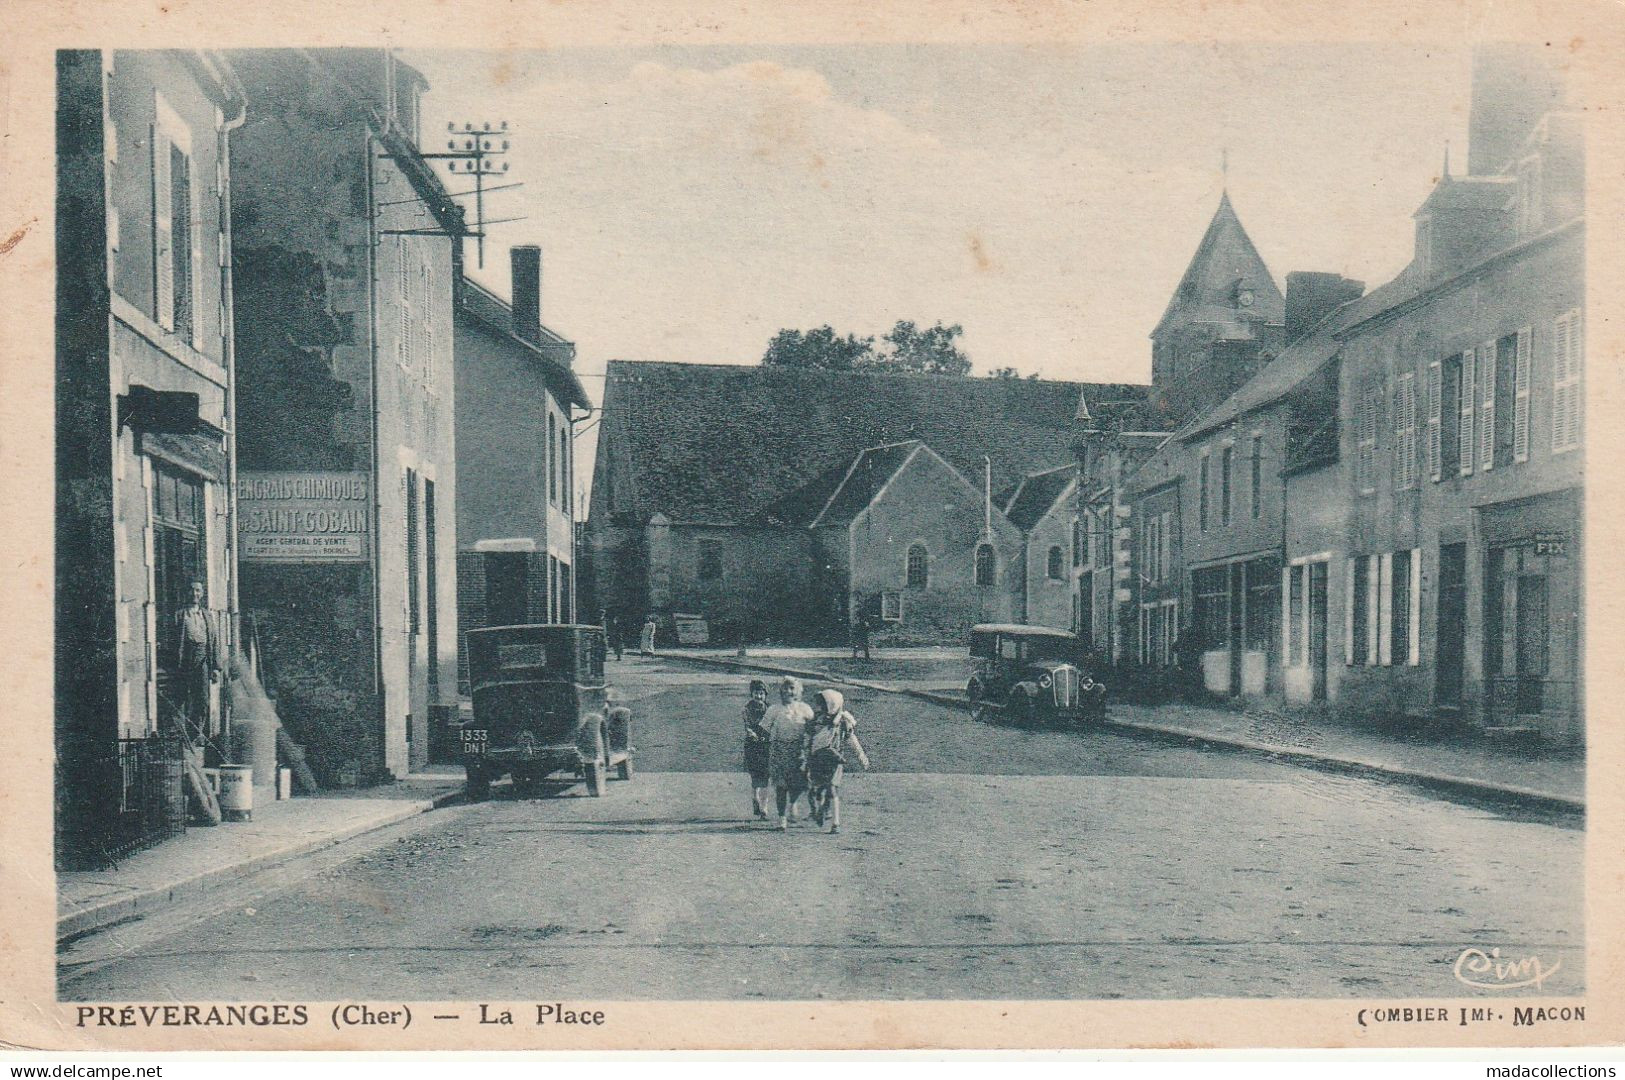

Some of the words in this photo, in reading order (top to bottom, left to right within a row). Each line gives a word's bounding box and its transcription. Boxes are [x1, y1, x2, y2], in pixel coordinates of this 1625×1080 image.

[238, 479, 292, 500] ENGRAIS
[294, 479, 368, 501] CHIMIQUES
[250, 509, 368, 533] SAINT-GOBAIN
[1537, 542, 1564, 553] FIX
[460, 729, 488, 741] 1333
